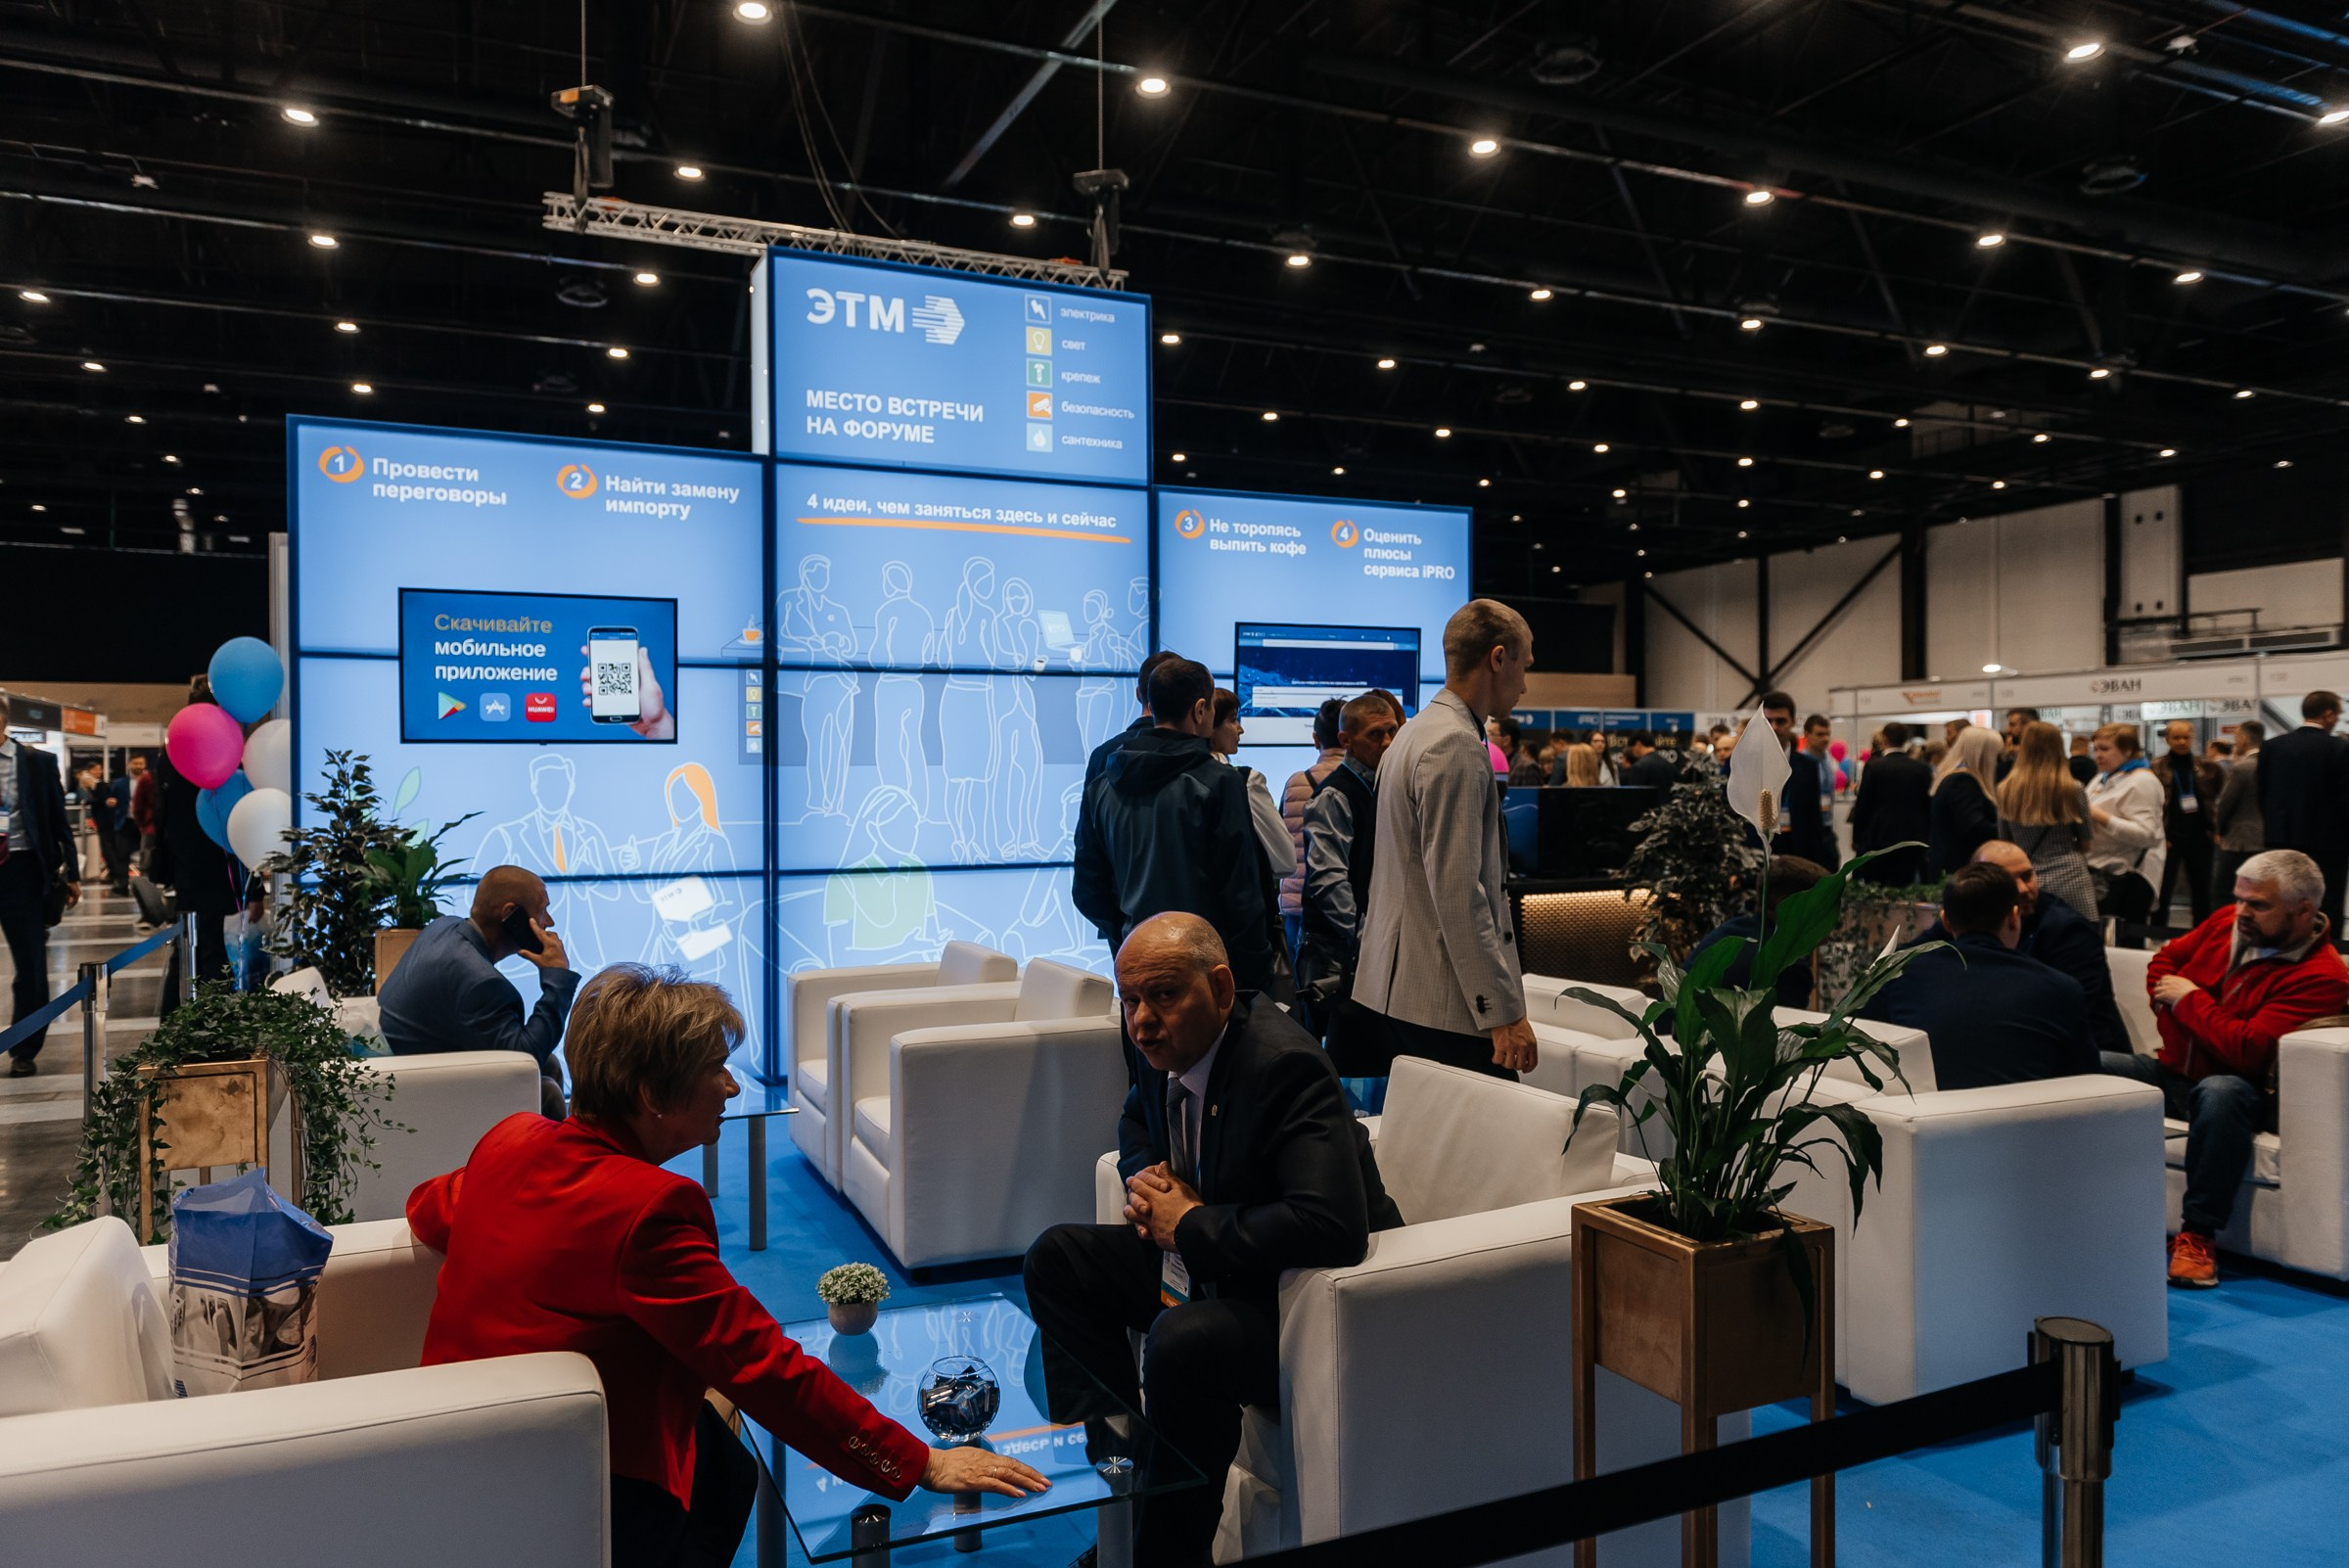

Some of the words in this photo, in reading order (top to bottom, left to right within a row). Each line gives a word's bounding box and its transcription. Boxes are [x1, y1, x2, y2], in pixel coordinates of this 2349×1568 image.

[806, 288, 904, 333] ЭТМ
[1060, 306, 1116, 324] электрика
[1061, 338, 1086, 351] свет
[1061, 370, 1101, 387] крепеж
[806, 390, 882, 414] МЕСТО
[888, 396, 984, 422] ВСТРЕЧИ
[1061, 401, 1135, 419] безопасность
[806, 416, 838, 437] НА
[843, 419, 935, 443] ФОРУМЕ
[1061, 434, 1123, 449] сантехника
[335, 455, 345, 472] 1
[373, 457, 479, 483] Провести
[571, 472, 583, 489] 2
[605, 475, 667, 496] Найти
[670, 484, 740, 504] замену
[373, 483, 507, 507] переговоры
[605, 499, 691, 521] импорту
[806, 493, 818, 509] 4
[823, 496, 872, 515] идеи,
[877, 500, 910, 516] чем
[914, 502, 991, 521] заняться
[995, 506, 1043, 525] здесь
[1047, 511, 1058, 525] и
[1061, 509, 1117, 529] сейчас
[1184, 517, 1194, 530] 3
[1210, 518, 1229, 533] Не
[1232, 522, 1301, 538] торопясь
[1340, 527, 1350, 540] 4
[1363, 528, 1422, 546] Оценить
[1210, 539, 1267, 553] выпить
[1269, 540, 1307, 557] кофе
[1363, 547, 1411, 561] плюсы
[1363, 564, 1419, 579] сервиса
[1422, 565, 1455, 580] iPRO
[435, 614, 553, 634] Скачивайте
[435, 638, 546, 658] мобильное
[435, 664, 558, 682] приложение
[2218, 698, 2254, 714] ЭВА
